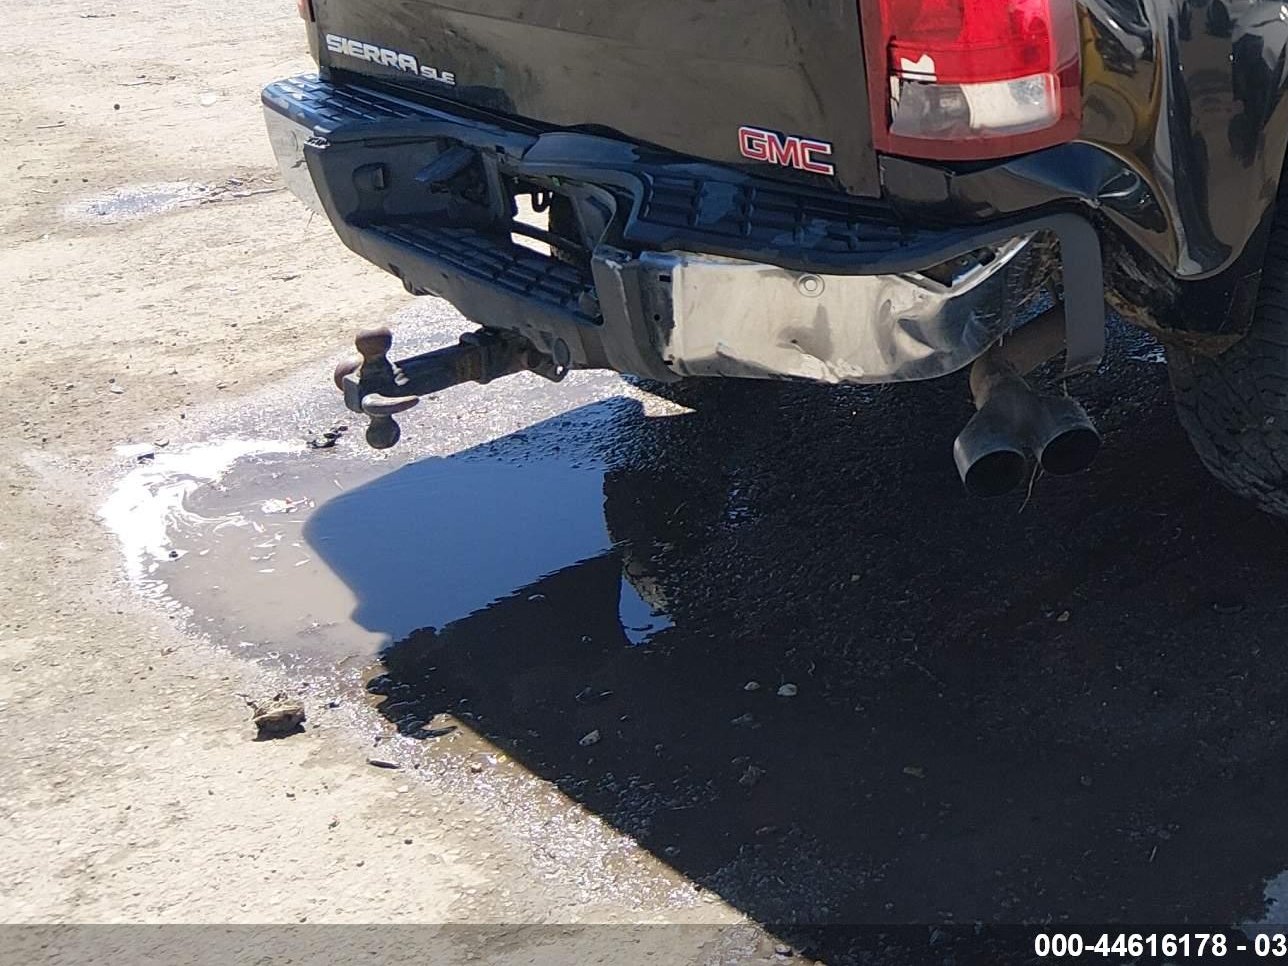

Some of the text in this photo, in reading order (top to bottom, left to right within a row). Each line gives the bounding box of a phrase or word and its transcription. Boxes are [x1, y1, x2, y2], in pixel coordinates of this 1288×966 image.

[326, 33, 456, 85] SIERRA SLE
[738, 126, 834, 176] GMC
